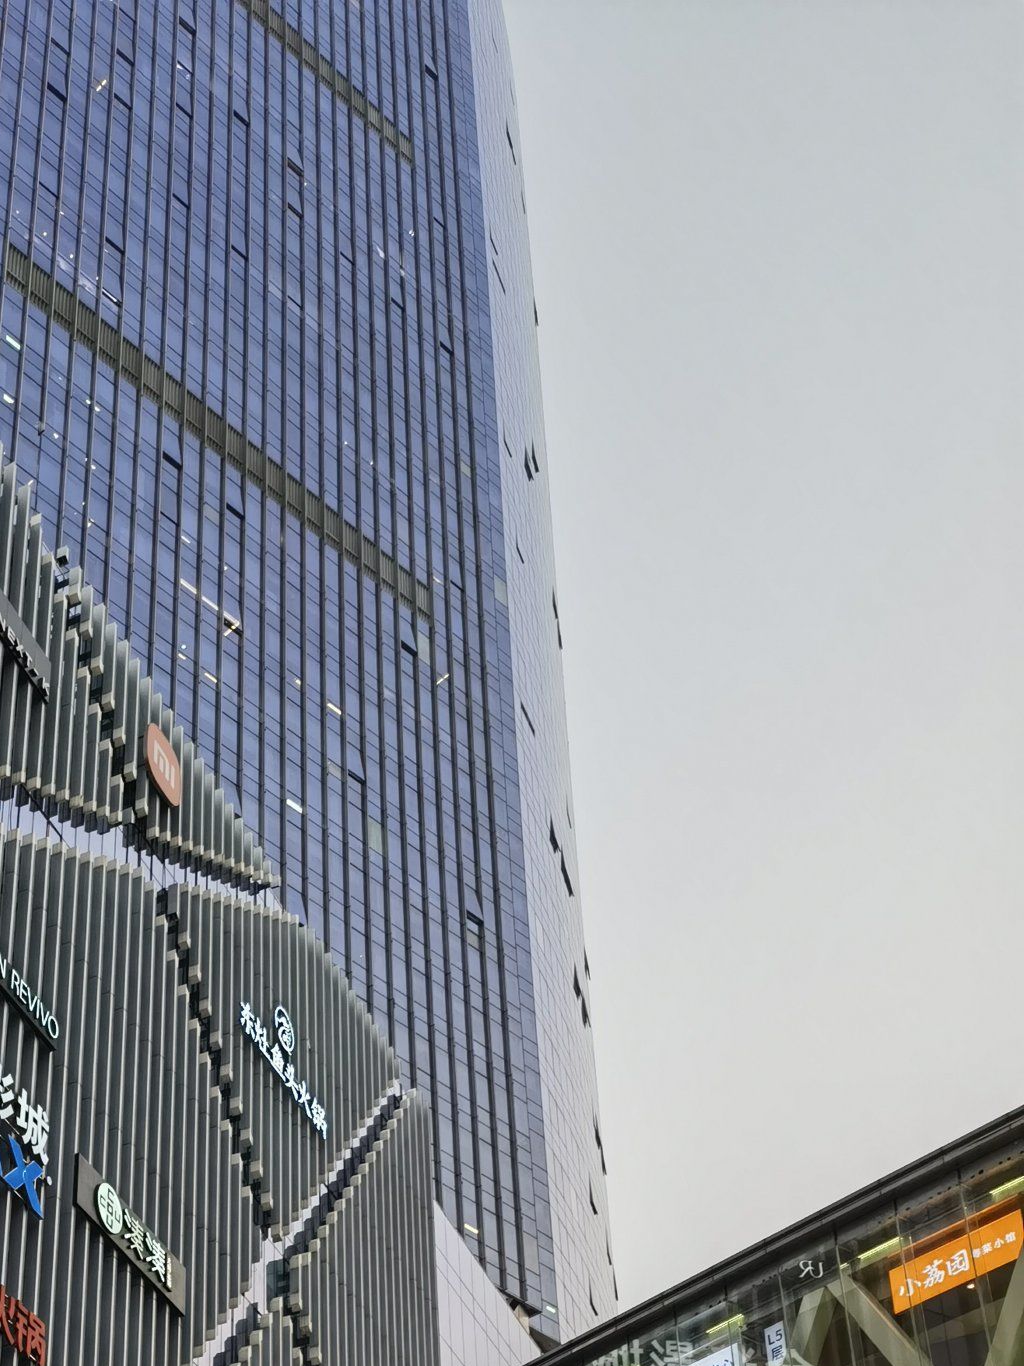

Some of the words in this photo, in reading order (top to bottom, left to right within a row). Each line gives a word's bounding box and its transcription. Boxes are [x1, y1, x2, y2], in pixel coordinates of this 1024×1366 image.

[10, 968, 60, 1040] REVIVO
[898, 1248, 970, 1297] 小荔园
[767, 1328, 783, 1347] L5
